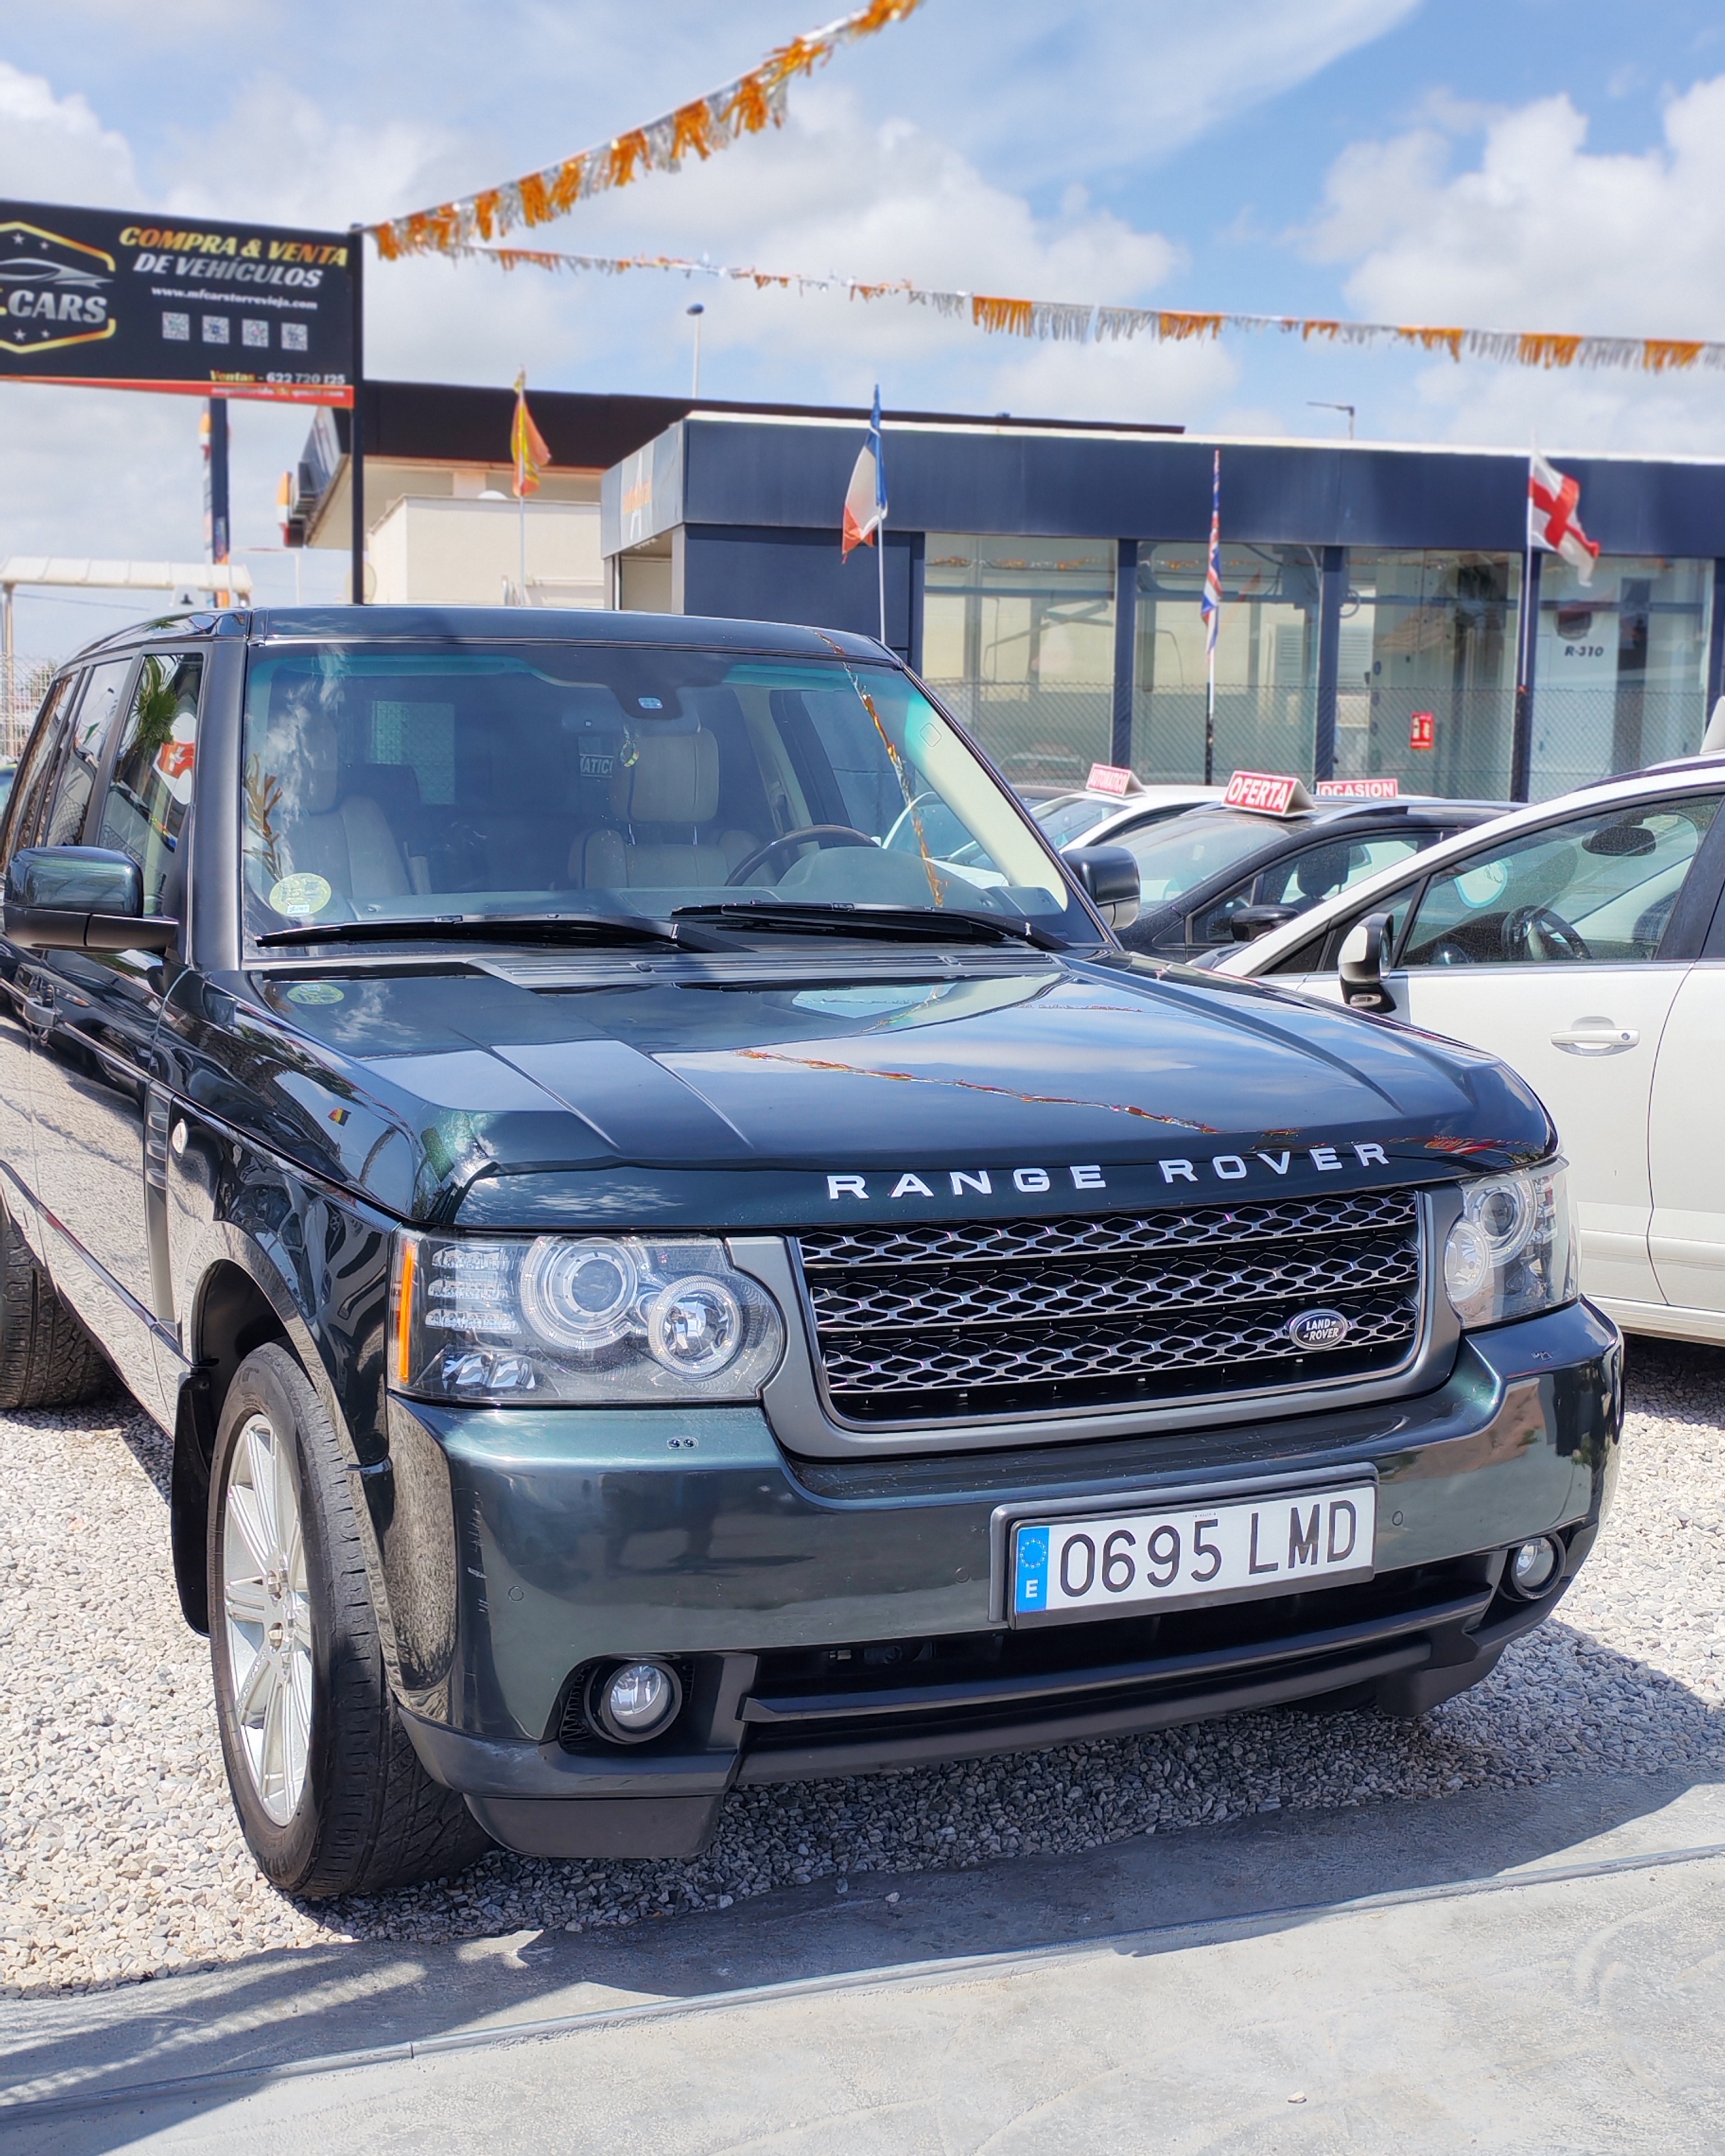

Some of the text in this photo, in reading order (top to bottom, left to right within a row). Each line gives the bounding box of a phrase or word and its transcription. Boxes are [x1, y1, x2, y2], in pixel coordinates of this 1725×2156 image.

[119, 227, 348, 266] COMPRA & VENTA
[133, 253, 323, 287] DE VEHÍCULOS
[8, 289, 107, 323] CARS
[266, 372, 292, 384] 622
[295, 373, 321, 384] 720
[323, 374, 346, 385] 125
[1227, 775, 1289, 809] OFERTA
[1320, 782, 1394, 798] OCASION
[827, 1143, 1389, 1199] RANGE ROVER
[1306, 1318, 1331, 1331] LAND
[1309, 1327, 1339, 1341] ROVER
[1060, 1500, 1357, 1597] 0695 LMD
[1025, 1579, 1039, 1598] E
